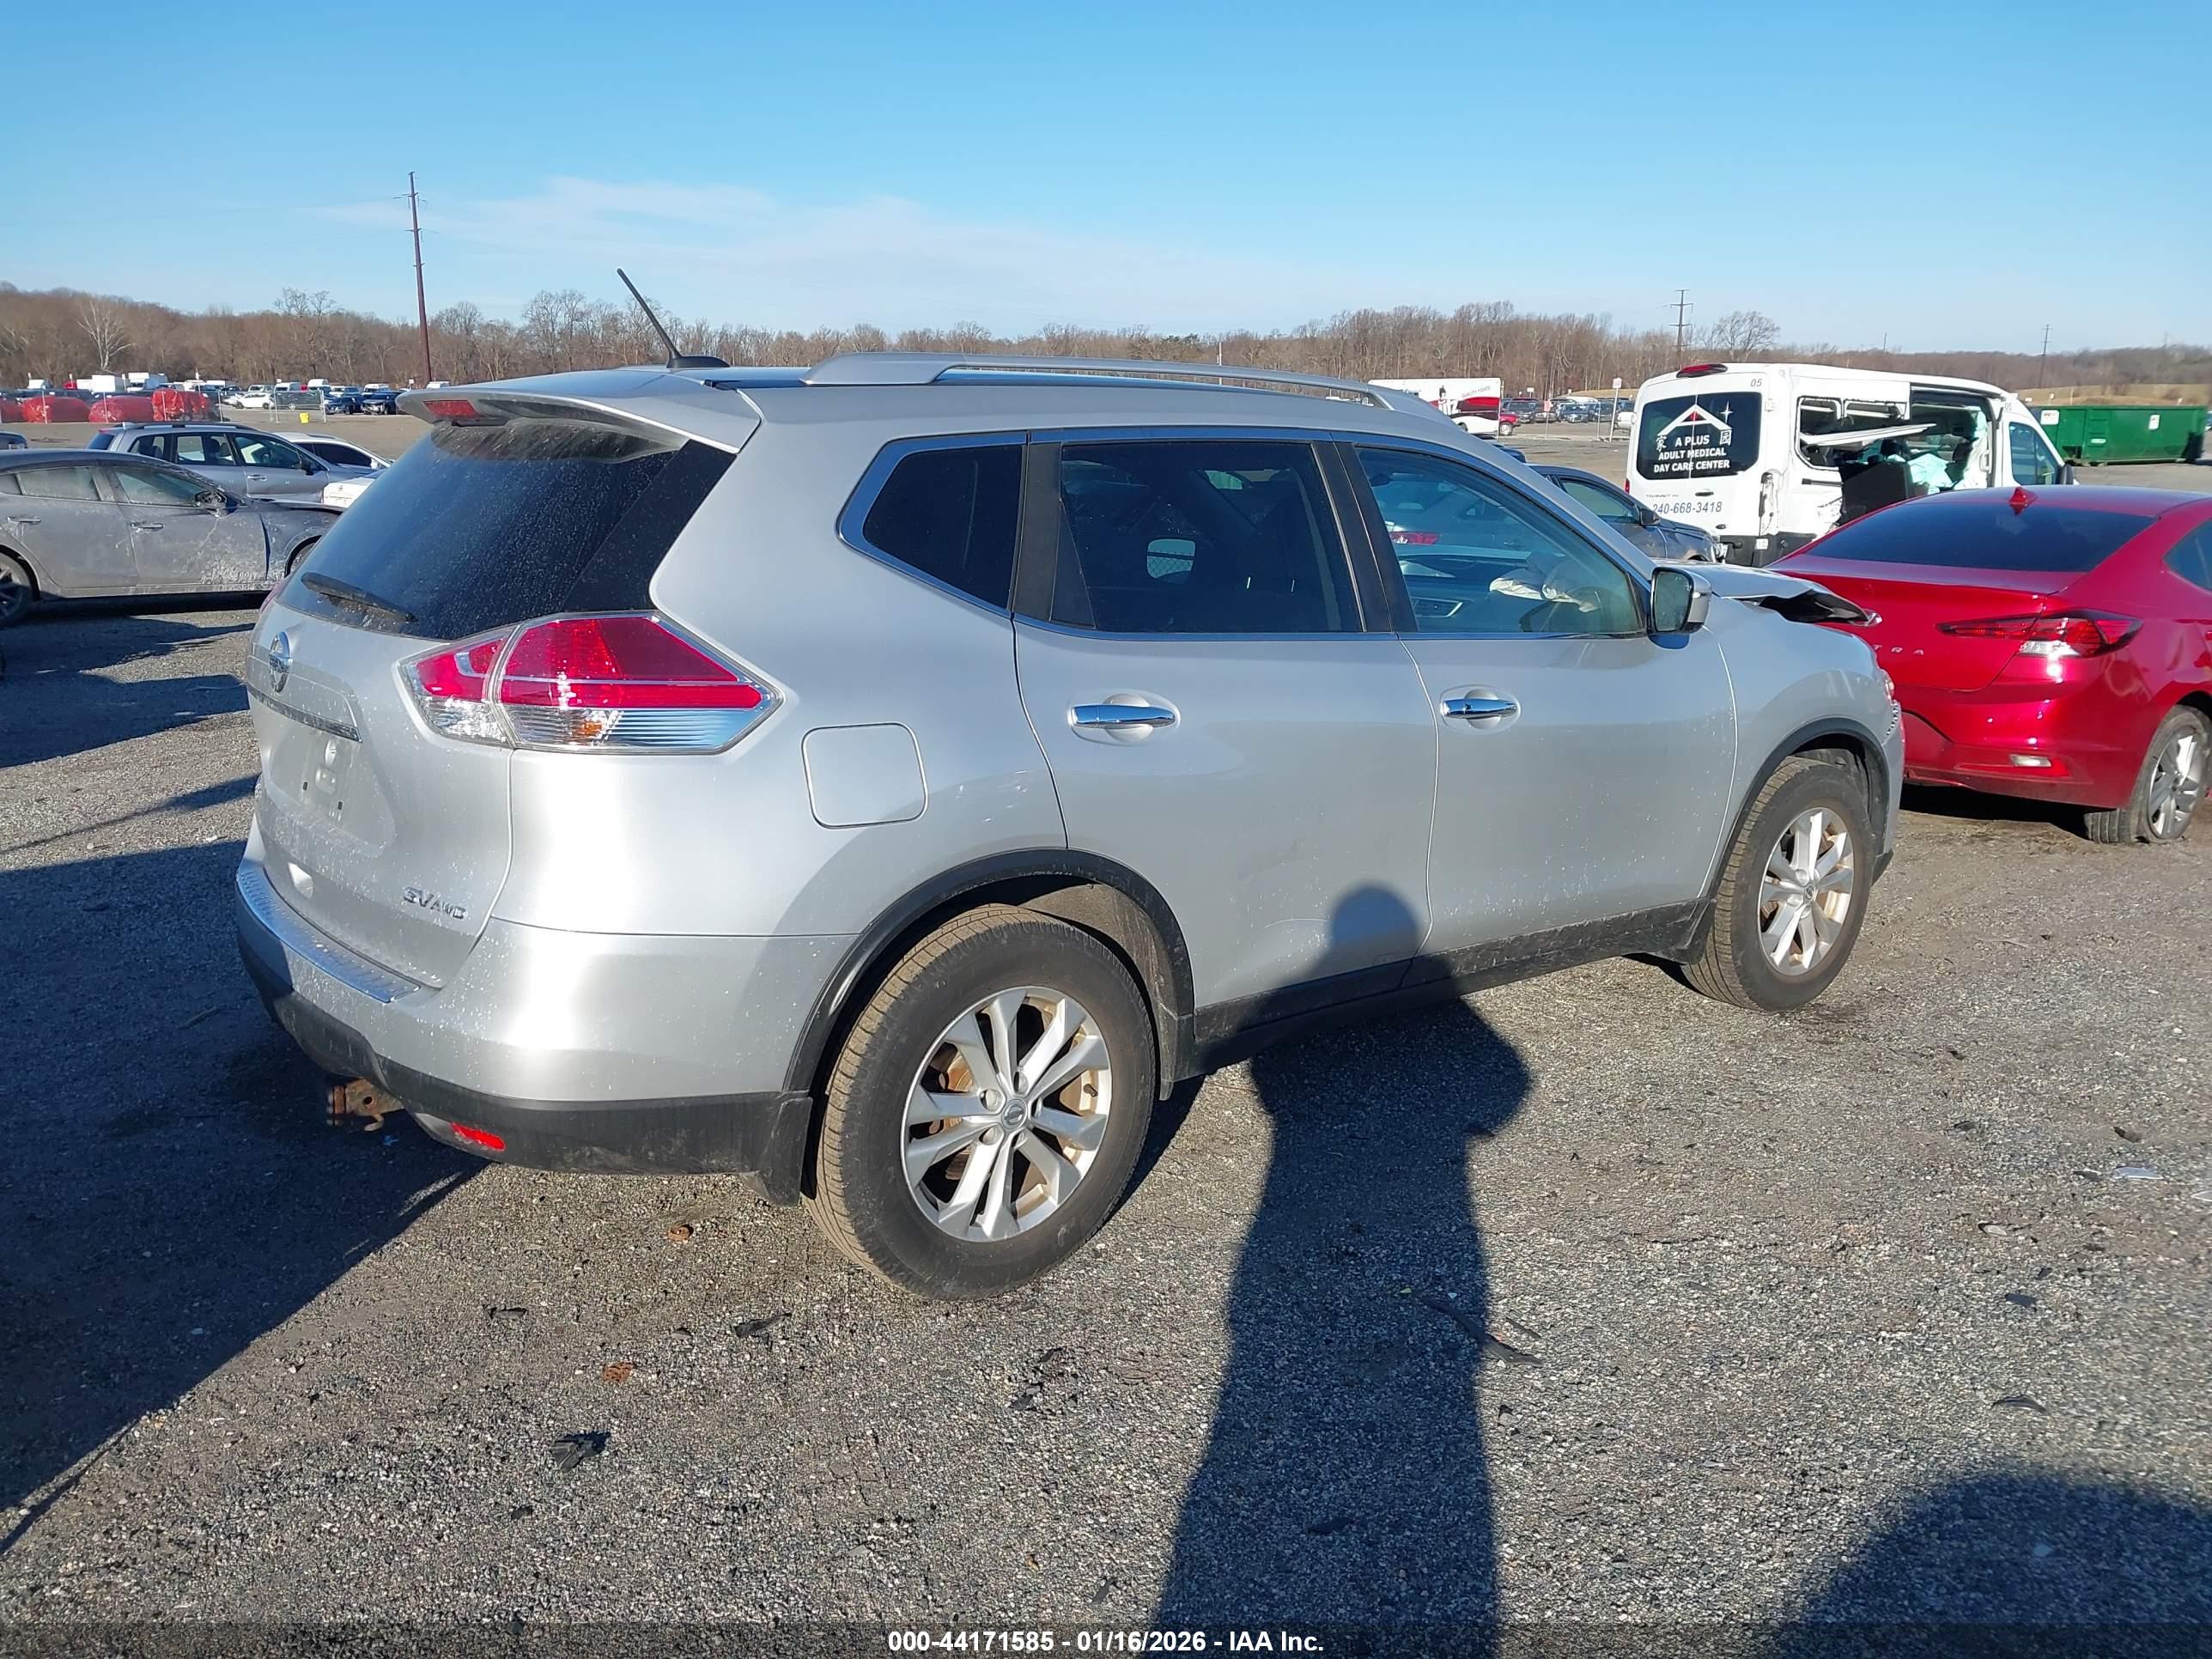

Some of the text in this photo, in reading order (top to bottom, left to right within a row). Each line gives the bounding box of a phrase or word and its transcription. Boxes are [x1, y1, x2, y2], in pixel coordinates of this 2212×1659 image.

[1750, 378, 1763, 387] 05
[1674, 434, 1710, 447] A PLUS
[1658, 447, 1727, 460] ADULT MEDICAL
[1653, 459, 1730, 472] DAY CARE CENTER
[1652, 501, 1723, 514] 240-668-3418
